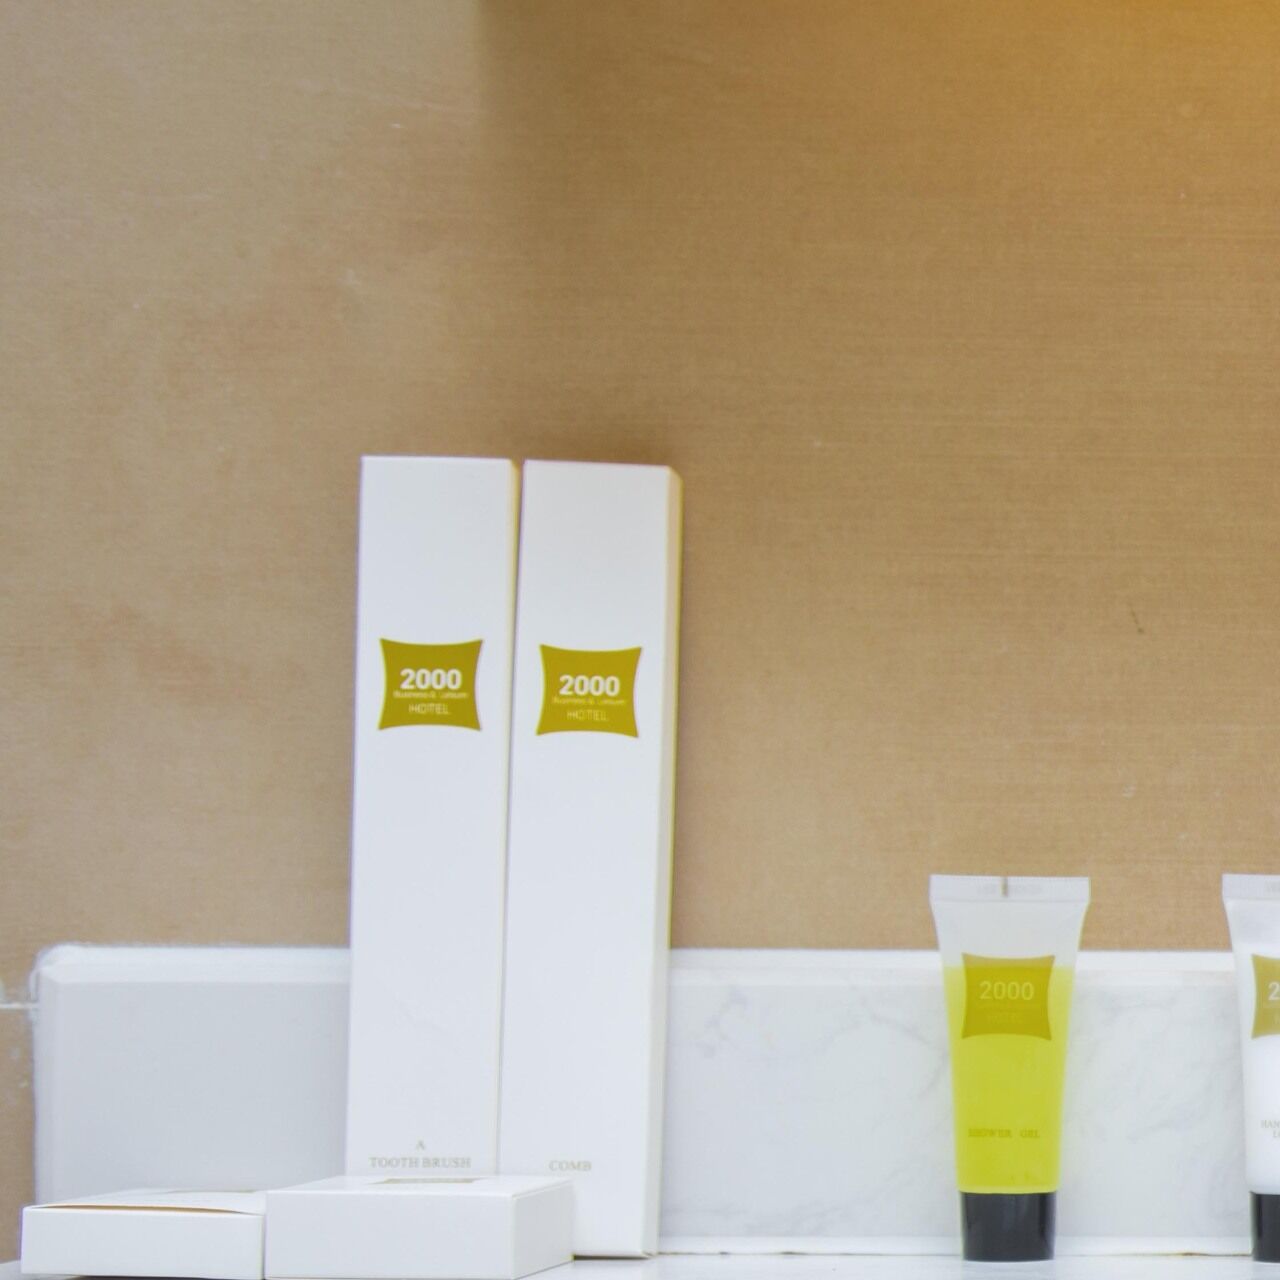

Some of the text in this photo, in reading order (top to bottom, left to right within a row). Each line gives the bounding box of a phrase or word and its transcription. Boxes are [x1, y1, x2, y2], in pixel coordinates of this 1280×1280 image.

[399, 668, 463, 691] 2000
[559, 674, 620, 698] 2000
[408, 702, 451, 715] HOTEL
[979, 980, 1035, 1001] 2000
[368, 1156, 473, 1170] TOOTH BRUSH
[548, 1159, 593, 1173] COMB
